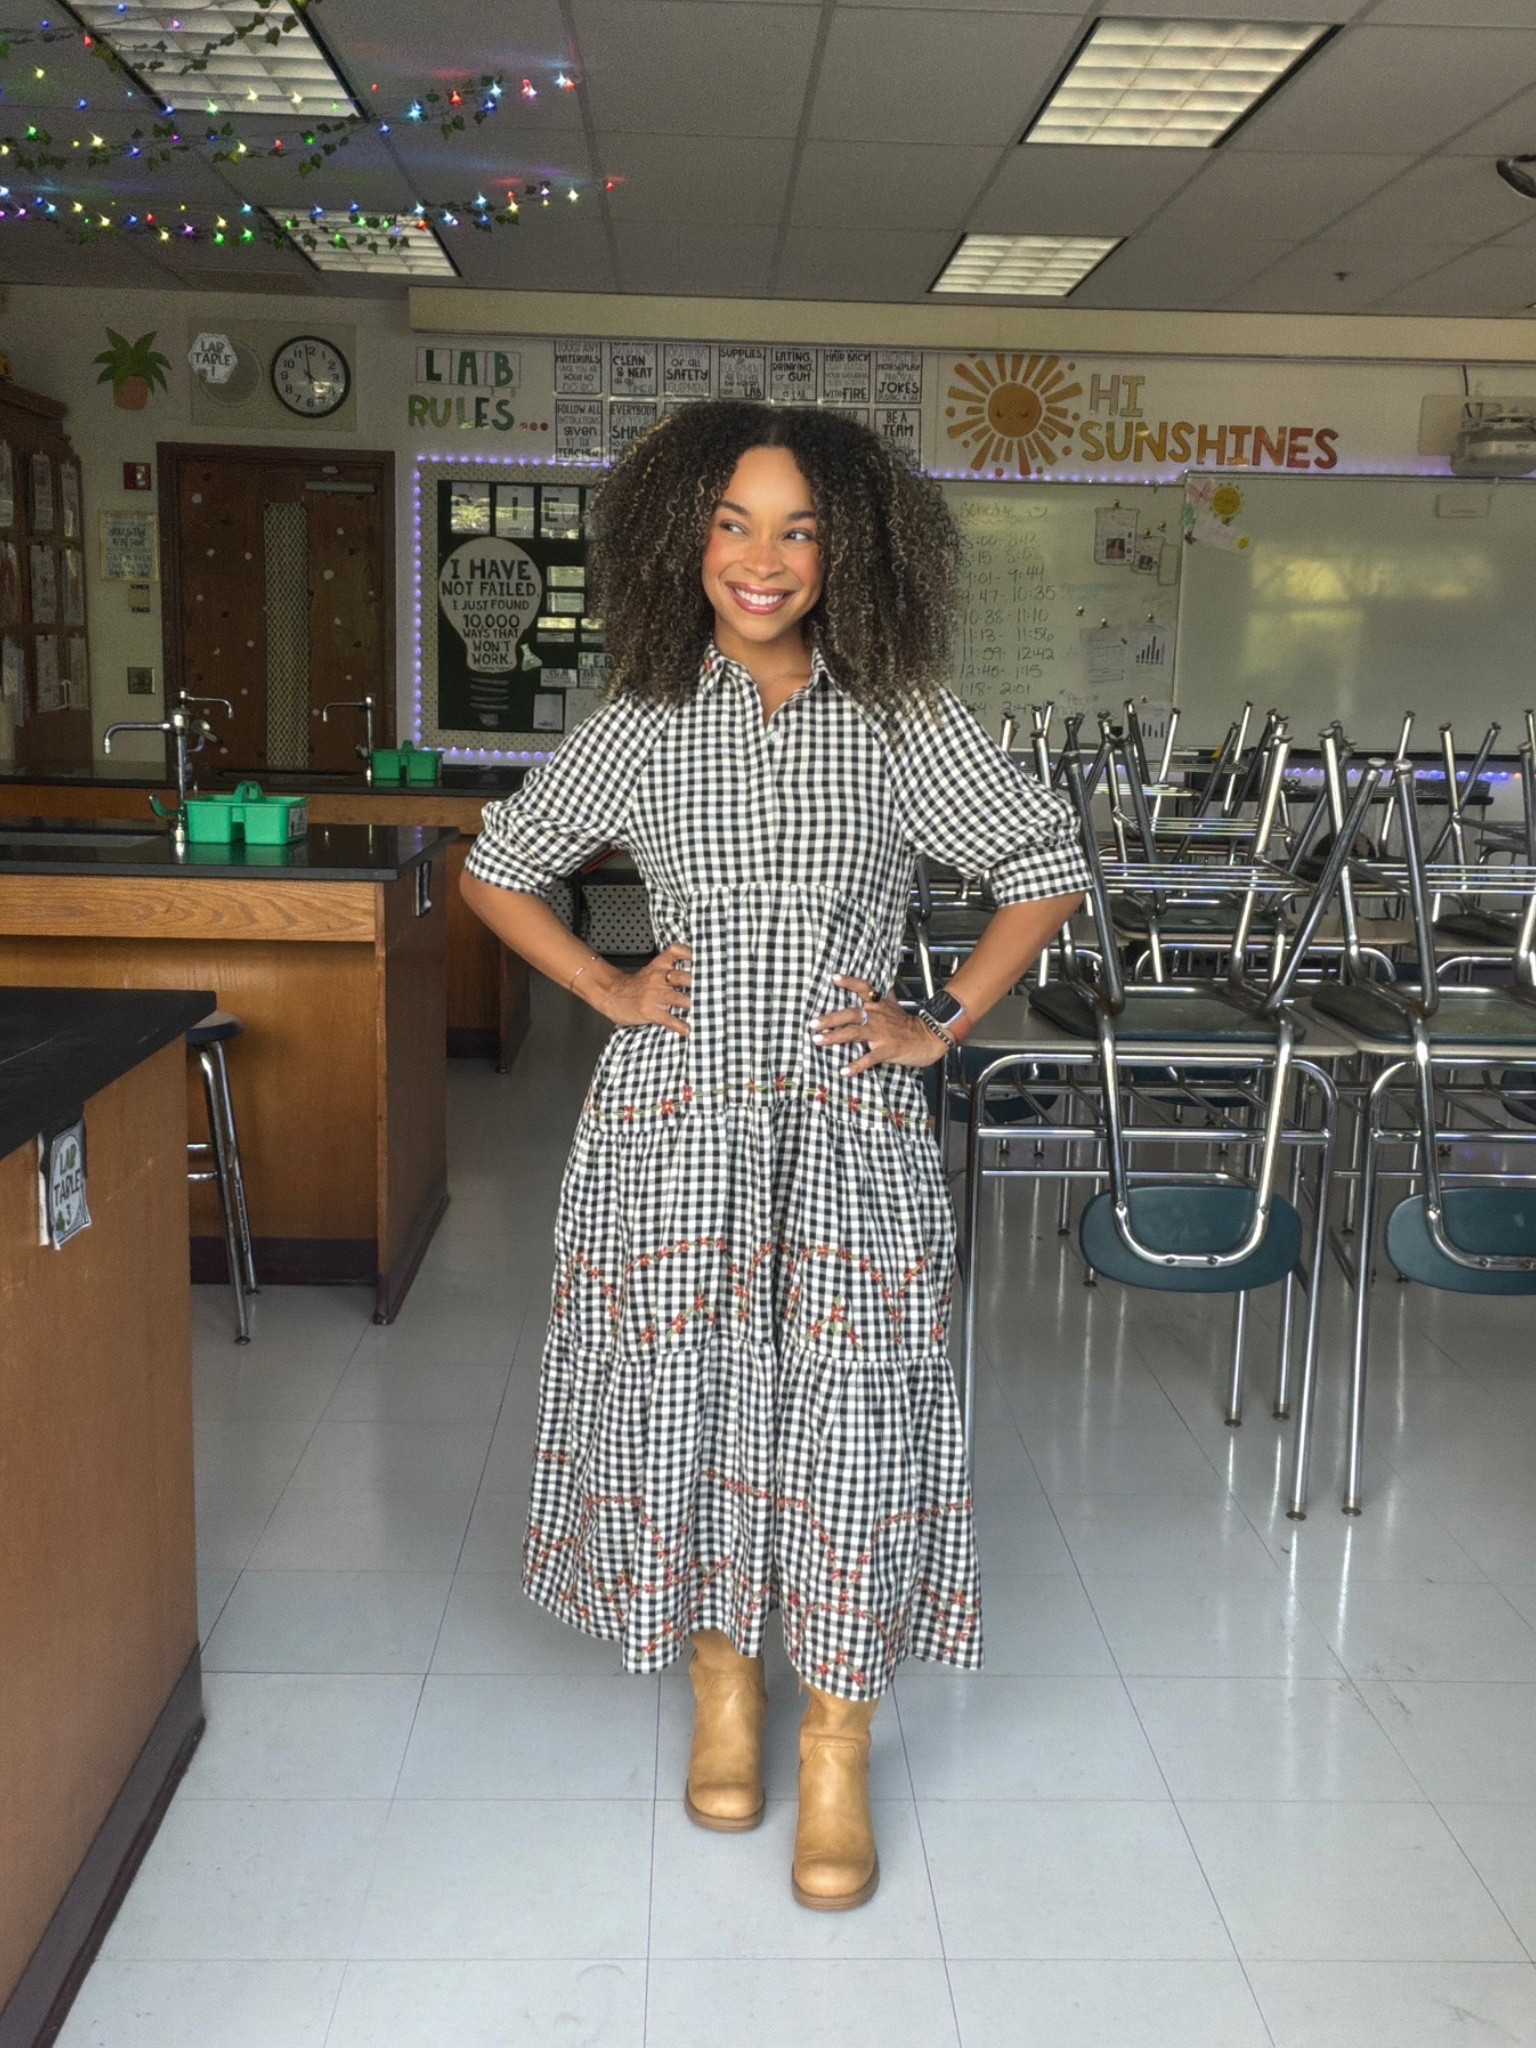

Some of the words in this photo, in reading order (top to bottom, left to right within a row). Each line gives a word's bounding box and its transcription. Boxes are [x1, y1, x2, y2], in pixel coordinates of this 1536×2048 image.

[201, 341, 225, 353] LAB
[193, 352, 231, 366] TABLE
[556, 354, 601, 364] MATERIALS
[613, 355, 646, 366] CLEAN
[775, 351, 812, 363] EATING,
[825, 353, 845, 362] HAIR
[847, 352, 870, 362] BACK
[425, 349, 514, 387] LAB
[628, 367, 653, 378] NEAT
[773, 362, 814, 373] DRINKING,
[666, 368, 708, 381] SAFETY
[788, 372, 810, 382] GUM
[843, 387, 866, 400] FIRE
[879, 382, 919, 394] JOKES
[1089, 373, 1145, 417] HI
[557, 403, 586, 414] FOLLOW
[588, 404, 600, 415] ALL
[611, 404, 657, 416] EVERYBODY
[886, 411, 897, 423] BE
[901, 411, 907, 423] A
[564, 426, 597, 437] given
[882, 424, 914, 438] TEAM
[1078, 421, 1339, 469] SUNSHINES
[450, 559, 460, 579] I
[469, 559, 531, 580] HAVE
[1008, 563, 1044, 583] 9:44
[441, 581, 473, 595] NOT
[480, 582, 540, 597] FAILED.
[1013, 584, 1055, 602] 10:35
[453, 600, 458, 610] I
[462, 600, 487, 611] JUST
[491, 600, 529, 610] FOUND
[1018, 606, 1048, 623] 11:10
[463, 614, 519, 629] 10,000
[463, 629, 490, 638] WAYS
[492, 629, 518, 638] THAT
[1017, 626, 1054, 642] 11:56
[473, 641, 510, 652] WON'T
[1018, 646, 1054, 661] 12:42
[1016, 663, 1043, 679] 1:15
[999, 681, 1030, 695] 2:01
[60, 1144, 77, 1176] LAB
[54, 1168, 81, 1207] TABLE
